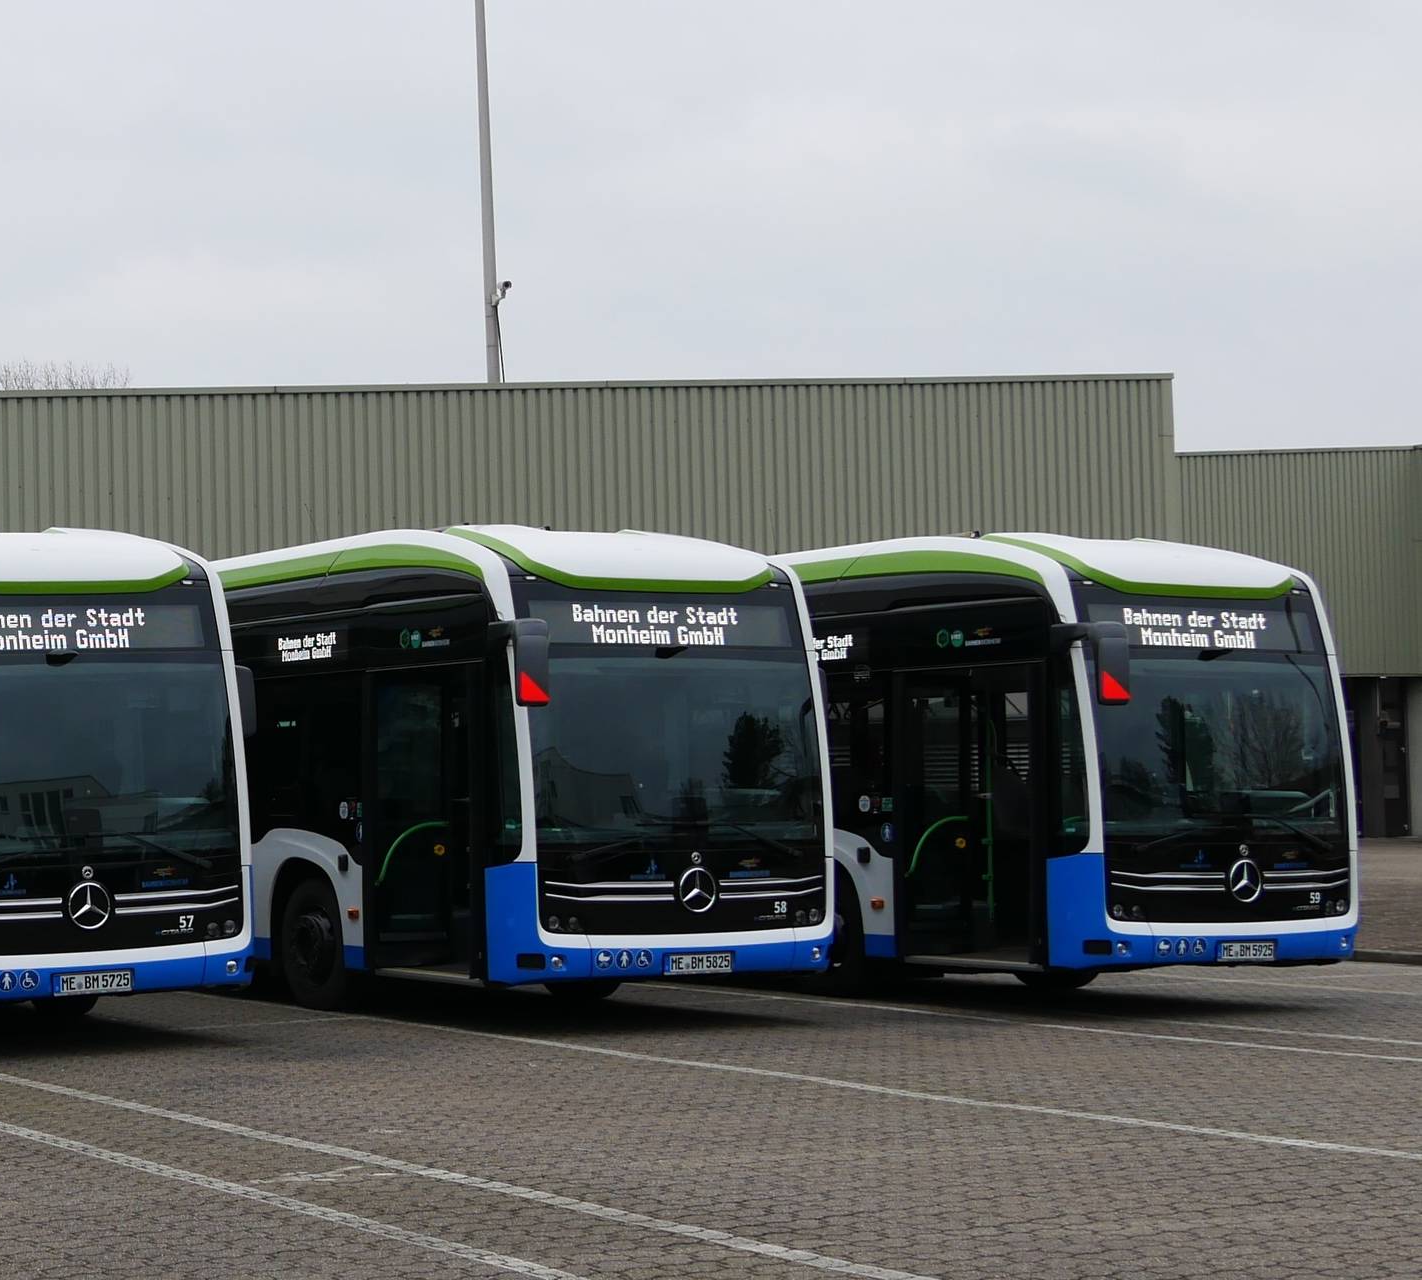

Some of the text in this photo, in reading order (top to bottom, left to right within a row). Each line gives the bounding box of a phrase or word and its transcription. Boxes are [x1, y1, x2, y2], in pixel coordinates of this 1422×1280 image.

[41, 609, 77, 628] der
[86, 607, 145, 627] Stadt
[571, 604, 738, 625] Bahnen der Stadt
[1123, 607, 1266, 630] Bahnen der Stadt
[75, 628, 130, 649] GmbH
[278, 632, 336, 650] Bahnen der Stadt
[591, 624, 725, 645] Monheim GmbH
[827, 634, 853, 649] Stadt
[1140, 627, 1256, 649] Monheim GmbH
[282, 646, 332, 662] Monheim GmbH
[821, 648, 848, 660] GmbH
[1309, 892, 1321, 904] 59
[773, 901, 787, 913] 58
[179, 915, 194, 928] 57
[1223, 943, 1274, 957] ME BM 5925
[671, 954, 730, 971] ME BM 5825
[61, 973, 130, 992] ME BM 5725
